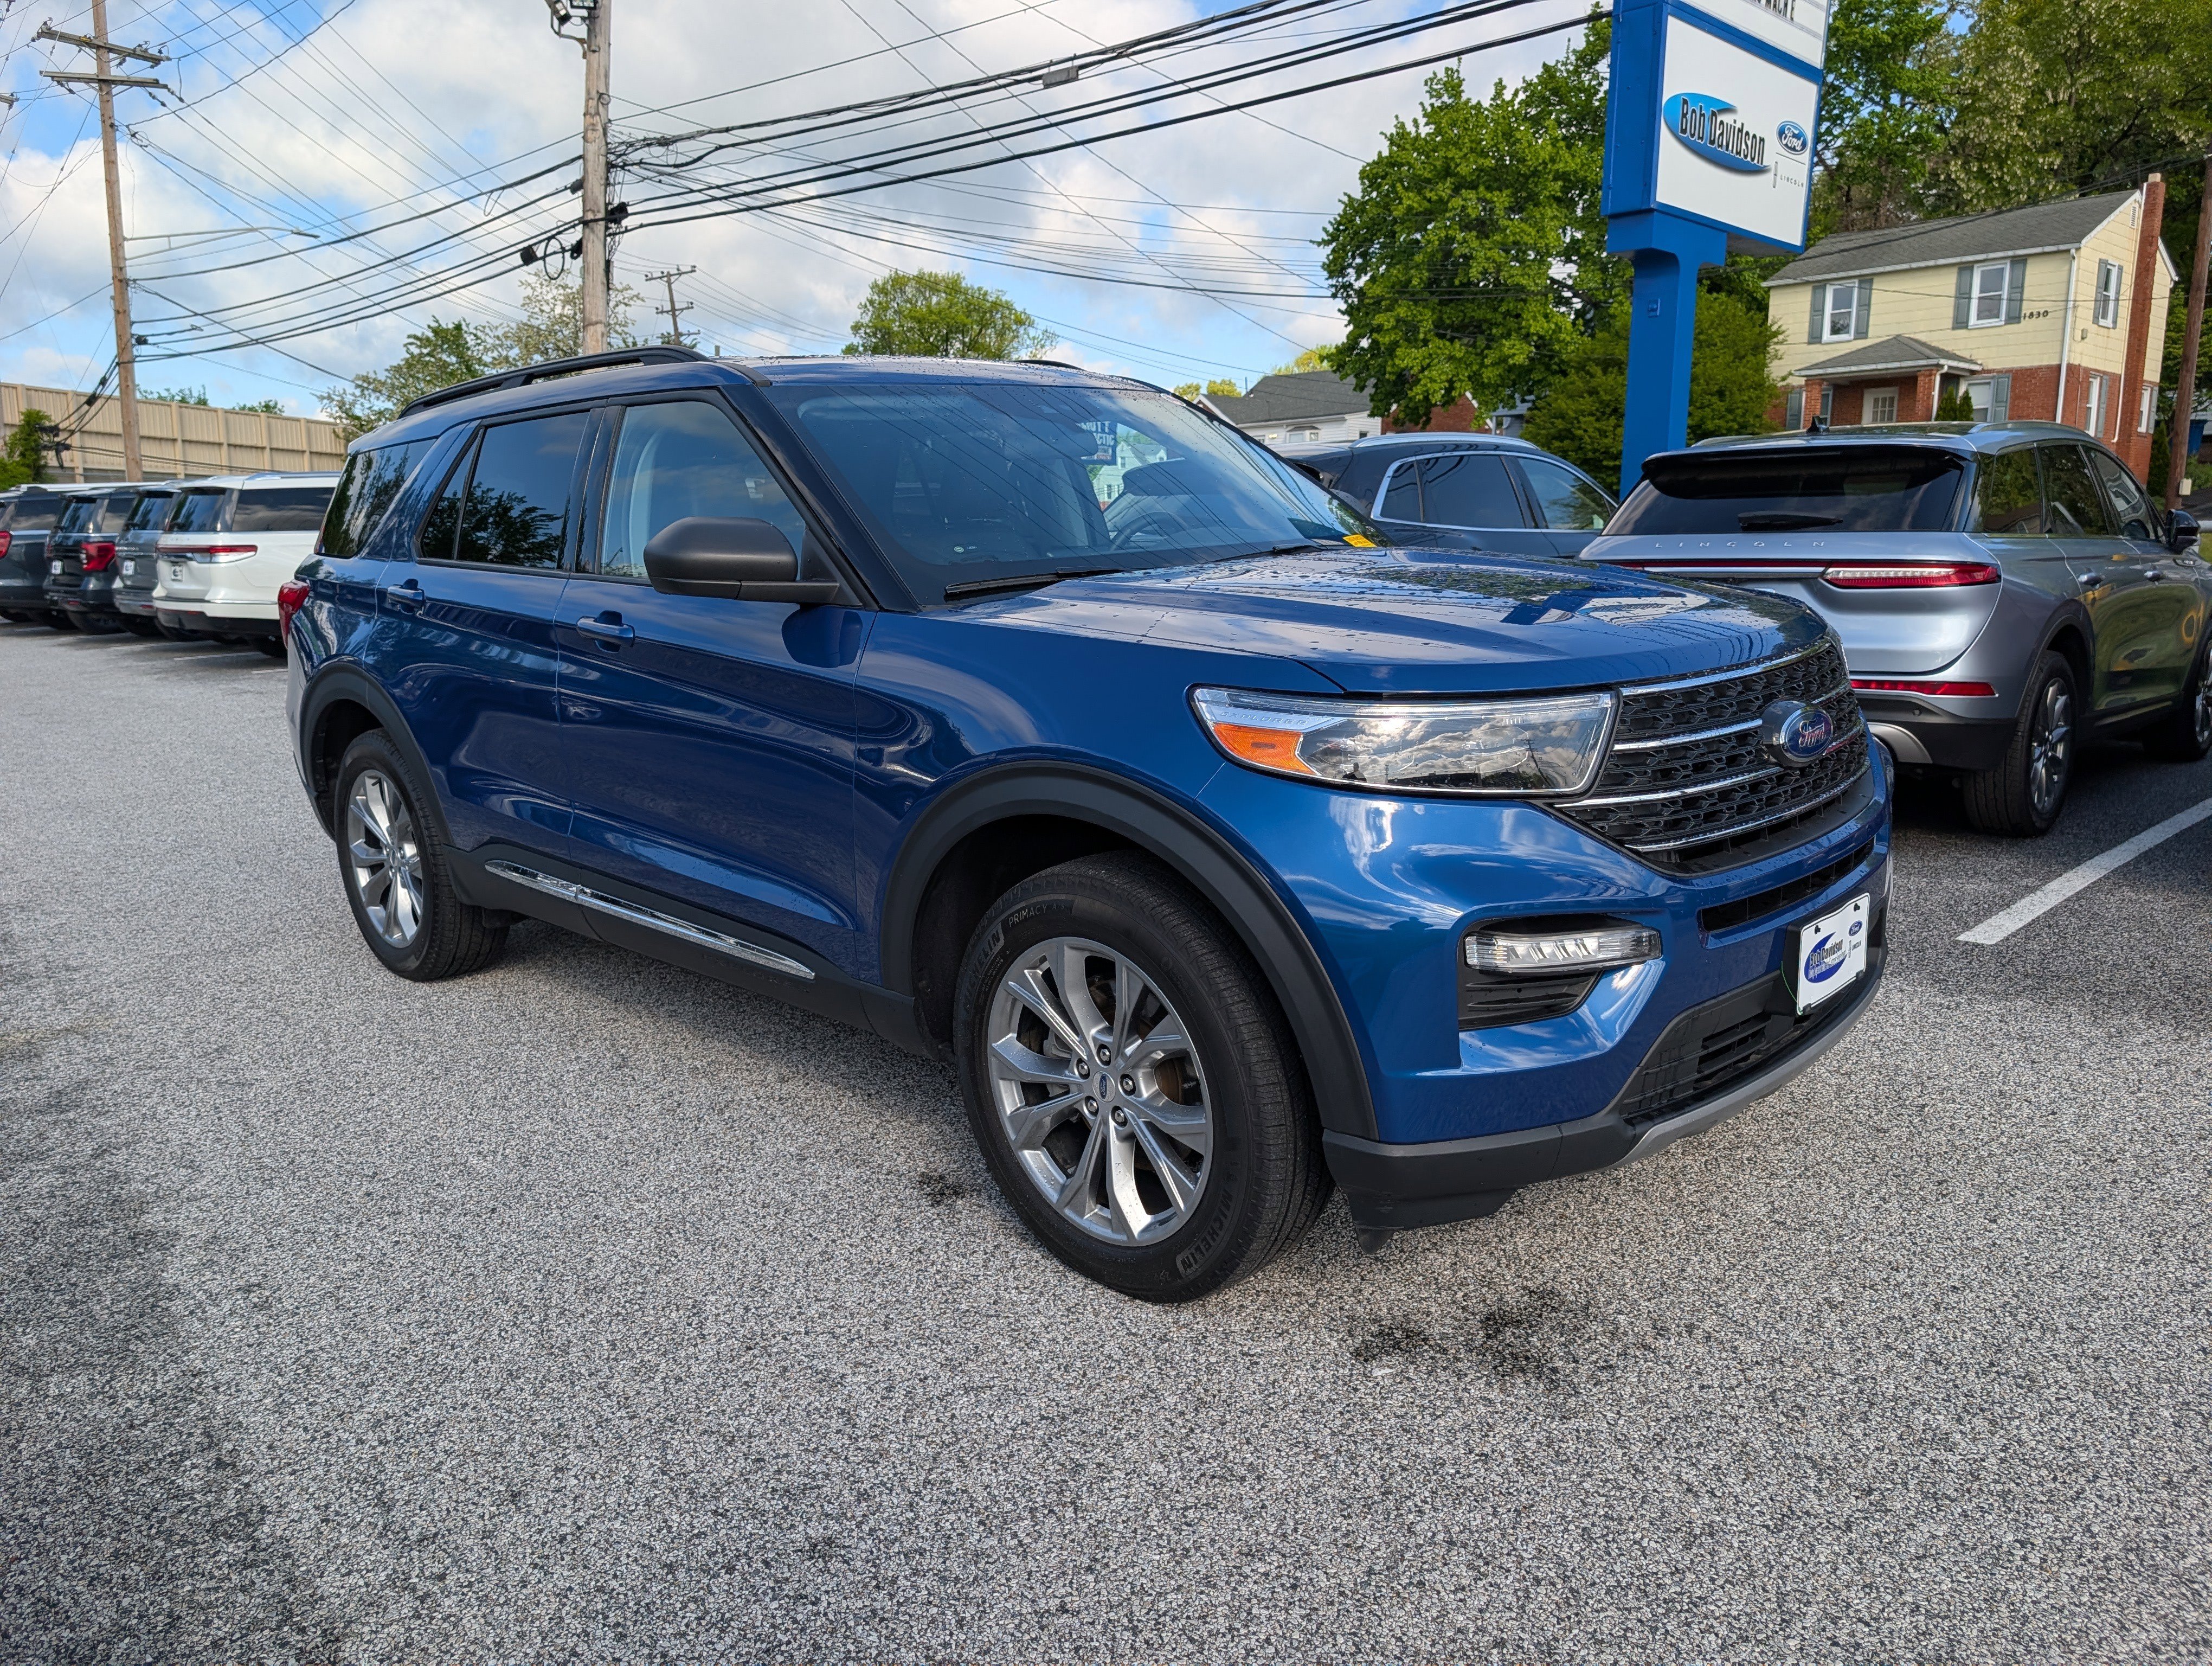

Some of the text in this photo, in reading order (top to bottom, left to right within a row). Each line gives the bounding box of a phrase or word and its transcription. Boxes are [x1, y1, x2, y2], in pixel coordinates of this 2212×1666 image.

[1680, 97, 1765, 166] Bob Davidson
[1780, 124, 1804, 151] Ford
[1780, 174, 1804, 188] LINCOLN
[2023, 310, 2049, 321] 1830
[1220, 712, 1308, 726] EXPLORER
[1798, 717, 1826, 747] Ford
[1008, 904, 1047, 927] PRIMACY
[1810, 949, 1821, 967] Bob
[1821, 939, 1843, 961] Davidson
[1181, 1189, 1233, 1273] MICHELIN
